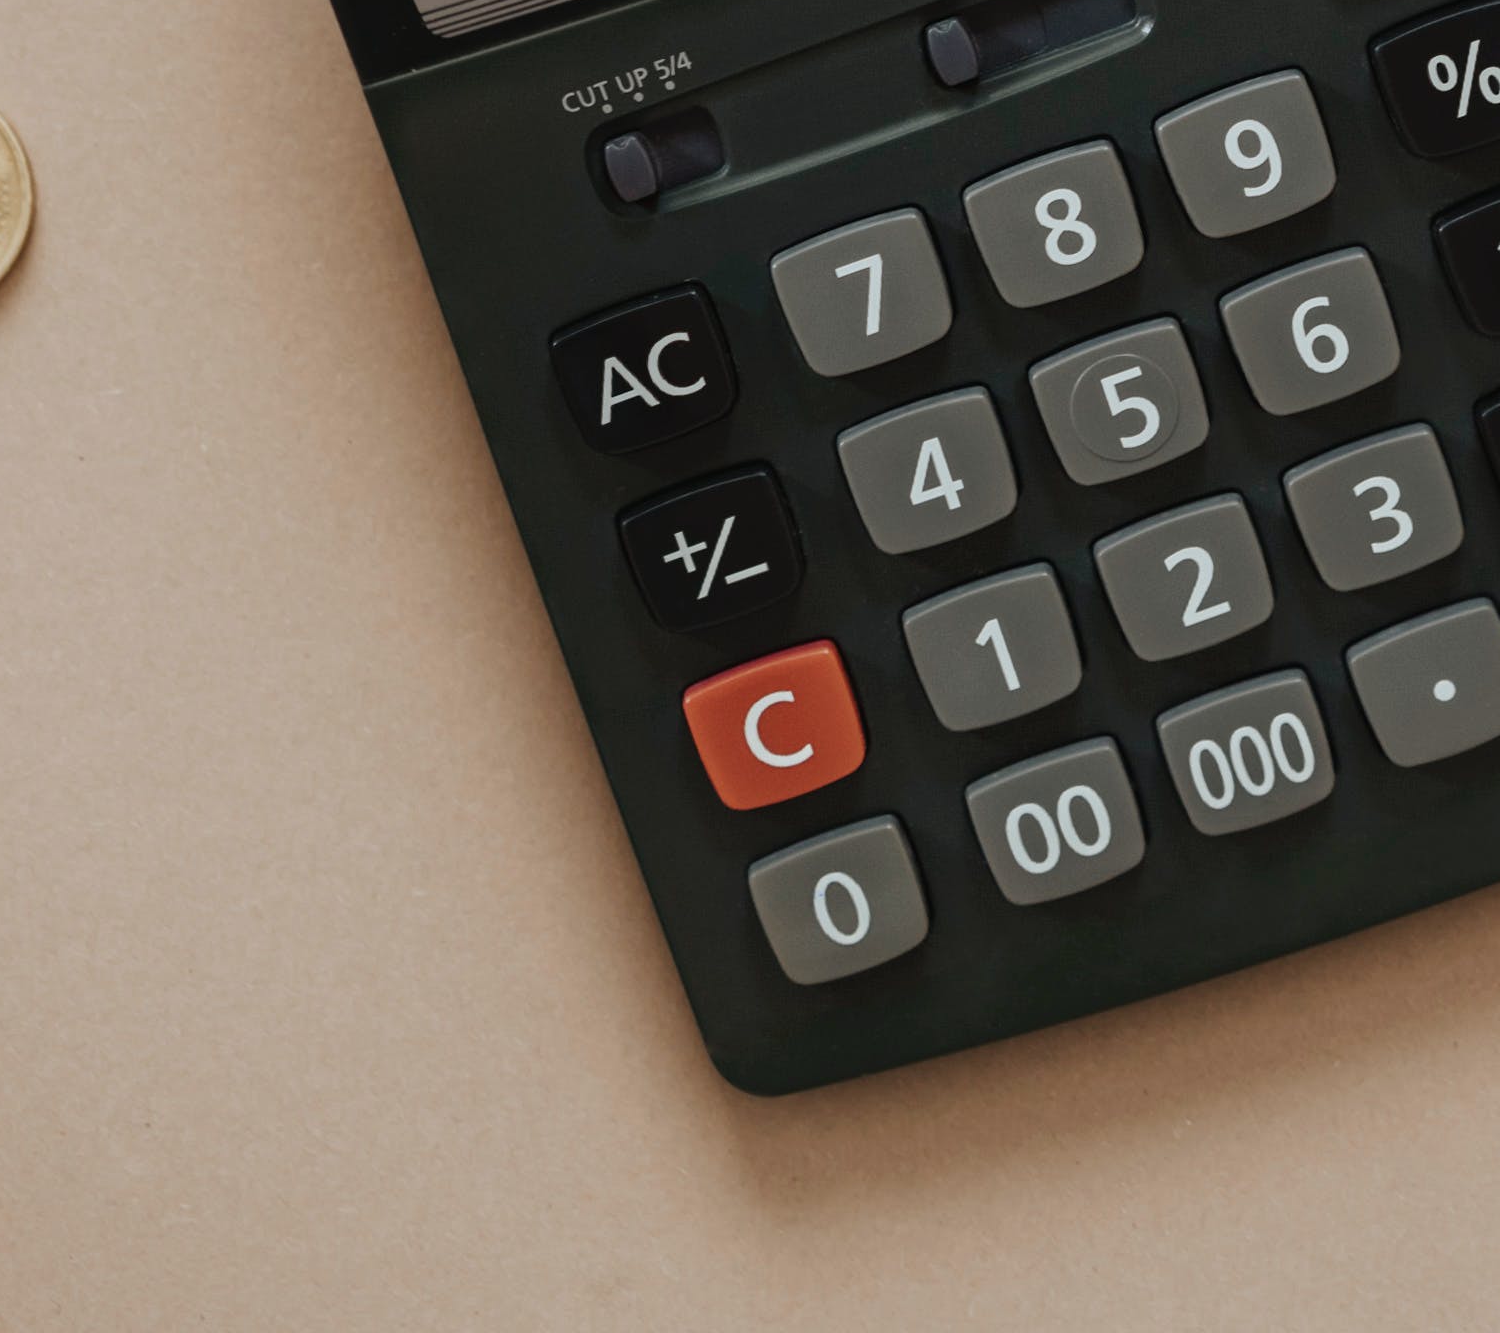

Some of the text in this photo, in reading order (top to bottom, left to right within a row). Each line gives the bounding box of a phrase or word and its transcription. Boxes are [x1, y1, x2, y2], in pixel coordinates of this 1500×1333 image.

[561, 49, 693, 114] CUT UP 5/4
[1224, 119, 1282, 197] 9
[1034, 188, 1097, 266] 8
[834, 253, 883, 336] 7
[1291, 296, 1350, 374] 6
[600, 332, 707, 426] AC
[1100, 366, 1160, 449] 5
[909, 436, 965, 510] 4
[1352, 475, 1414, 554] 3
[1163, 546, 1231, 627] 2
[975, 618, 1021, 691] 1
[744, 690, 814, 768] C
[1189, 712, 1315, 810] 000
[1005, 784, 1111, 874] 00
[813, 871, 871, 945] 0
